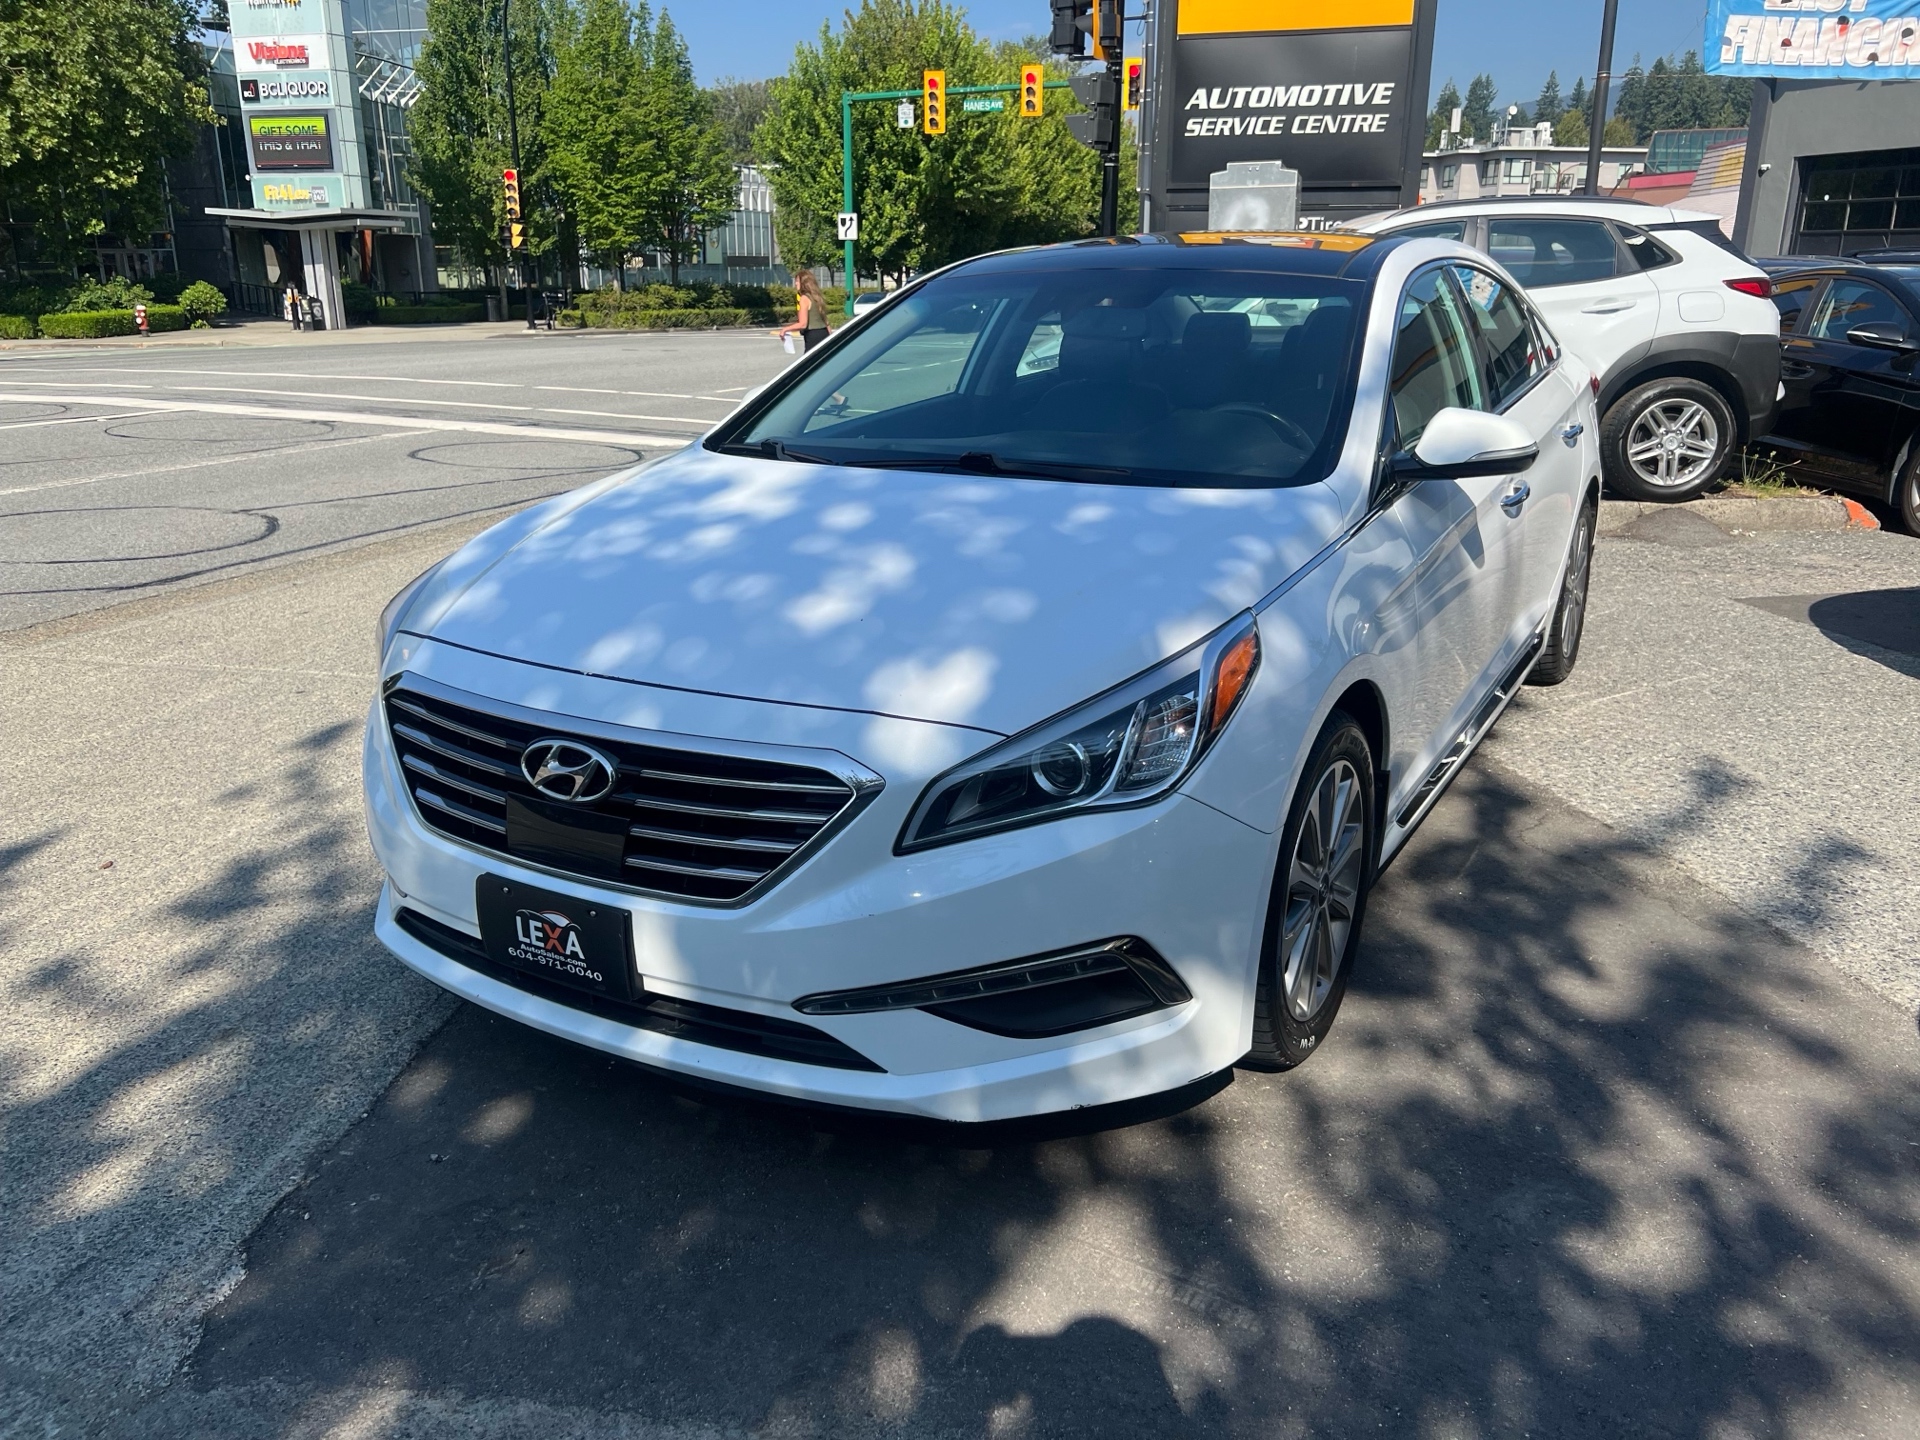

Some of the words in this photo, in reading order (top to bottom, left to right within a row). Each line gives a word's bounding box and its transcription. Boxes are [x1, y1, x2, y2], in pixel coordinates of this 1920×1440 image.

[248, 41, 306, 60] Visions
[964, 101, 990, 111] HANES
[990, 101, 1003, 109] AVE
[1184, 82, 1396, 111] AUTOMOTIVE
[259, 126, 283, 136] GIFT
[285, 125, 319, 136] SOME
[1184, 116, 1287, 137] SERVICE
[1291, 113, 1390, 135] CENTRE
[259, 141, 282, 151] THIS
[285, 141, 293, 150] &
[296, 141, 322, 150] THAT
[516, 915, 586, 960] LEXA
[508, 946, 603, 982] 604-971-0040
[521, 943, 588, 968] AutoSales.com
